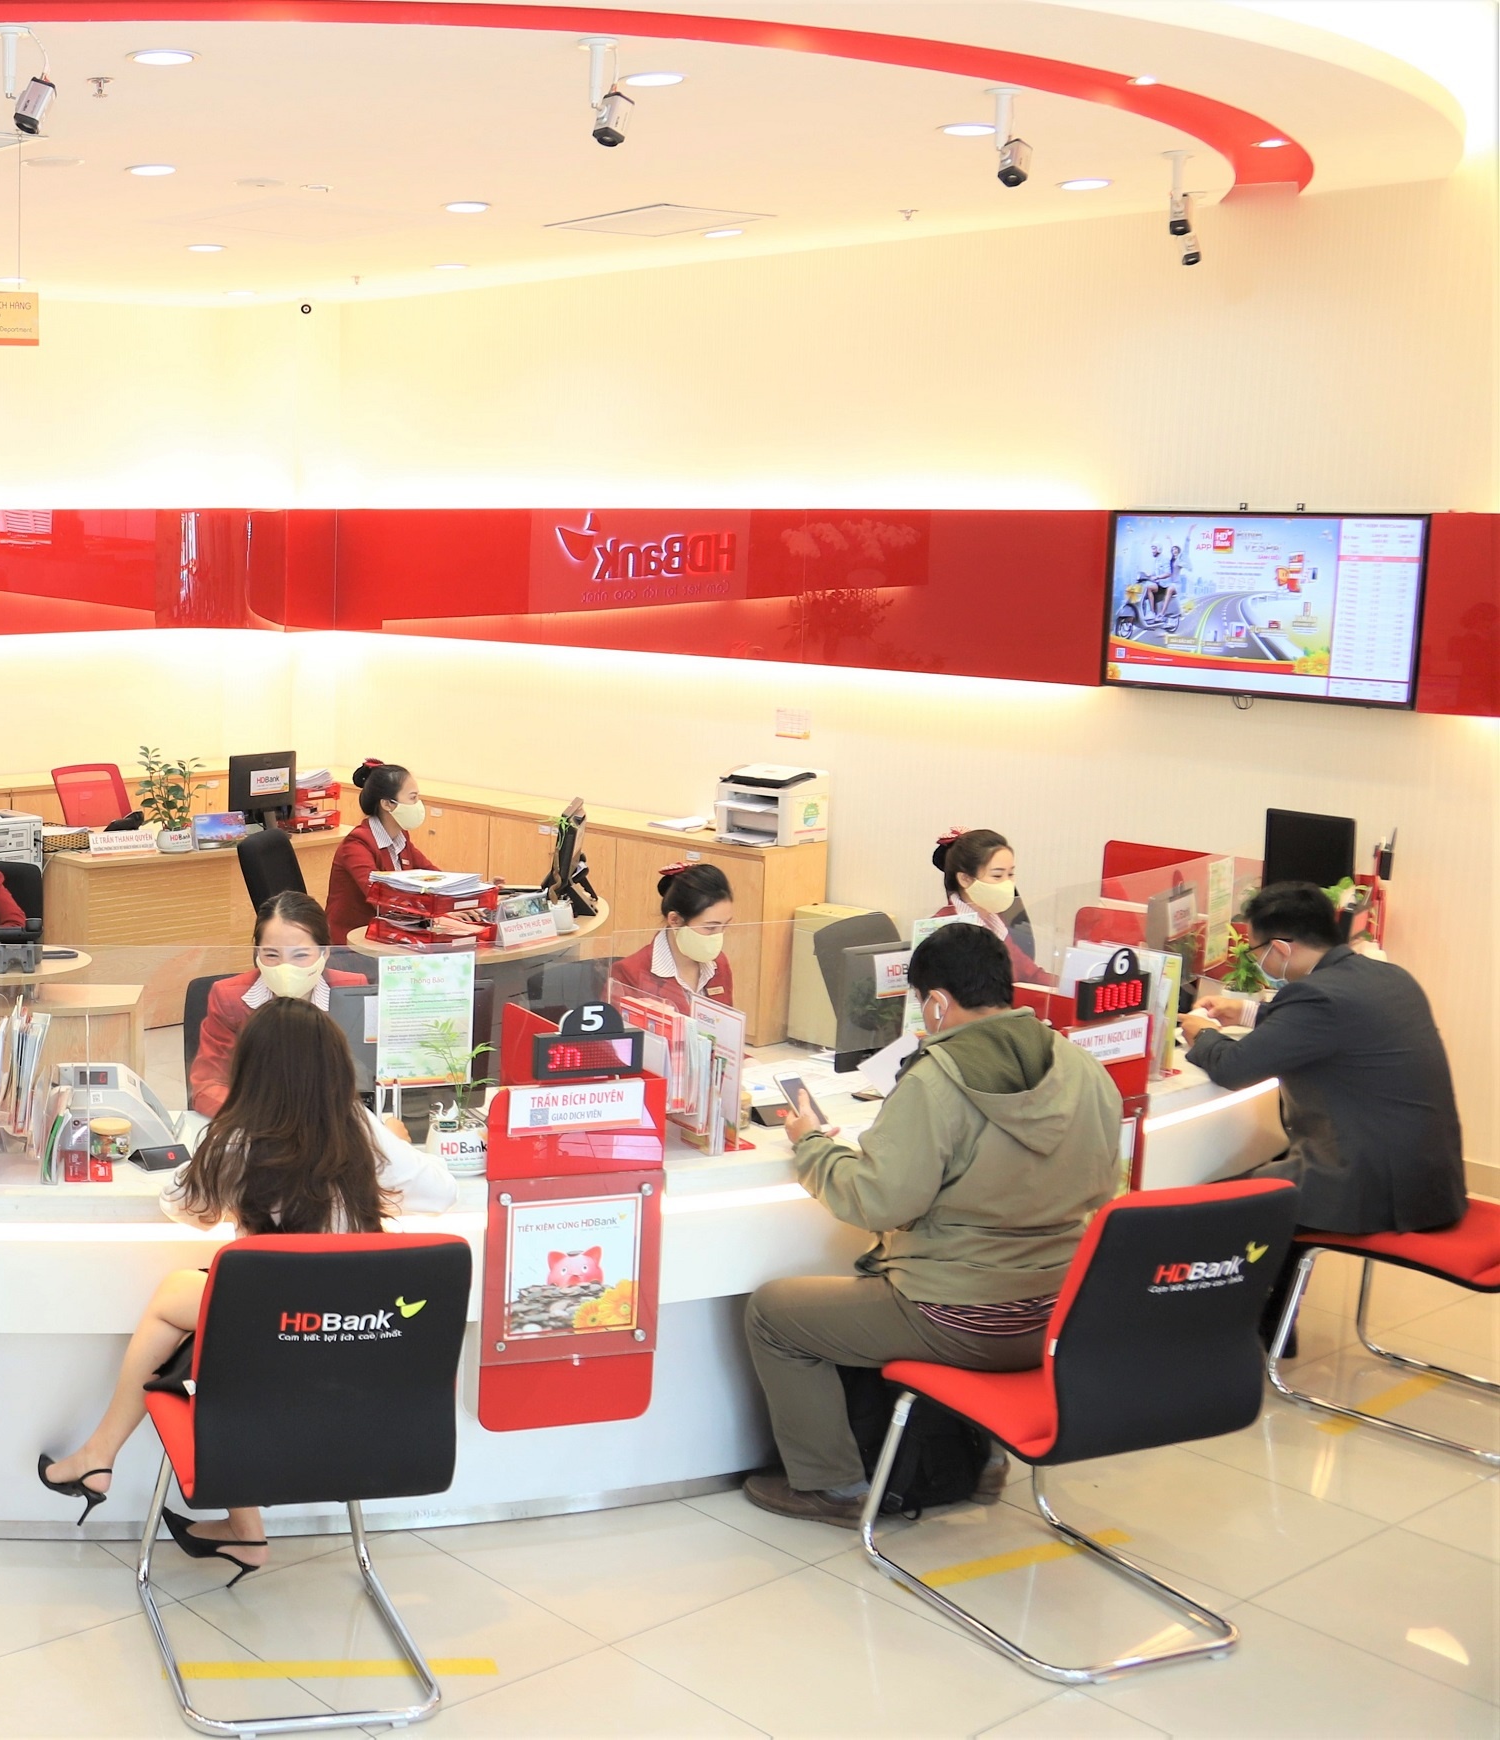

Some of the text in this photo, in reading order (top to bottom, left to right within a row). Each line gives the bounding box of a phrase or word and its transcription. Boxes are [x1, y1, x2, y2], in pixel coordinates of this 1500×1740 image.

[0, 325, 32, 333] Department
[256, 775, 280, 784] HDBank
[170, 833, 190, 841] HDBank
[387, 964, 412, 972] HDBank
[887, 963, 909, 977] HDB
[1113, 951, 1130, 975] 6
[1094, 979, 1143, 1013] 1010
[581, 1006, 604, 1032] 5
[562, 1090, 586, 1107] BÍCH
[588, 1089, 624, 1104] DUYÊN
[551, 1111, 568, 1121] GIAO
[440, 1141, 488, 1155] HDBank
[517, 1224, 533, 1233] TIẾT
[581, 1217, 617, 1228] HDBank
[1153, 1255, 1245, 1284] HDBank
[279, 1309, 394, 1332] HDBank
[278, 1329, 402, 1343] Cam kết lợi ích cao nhất
